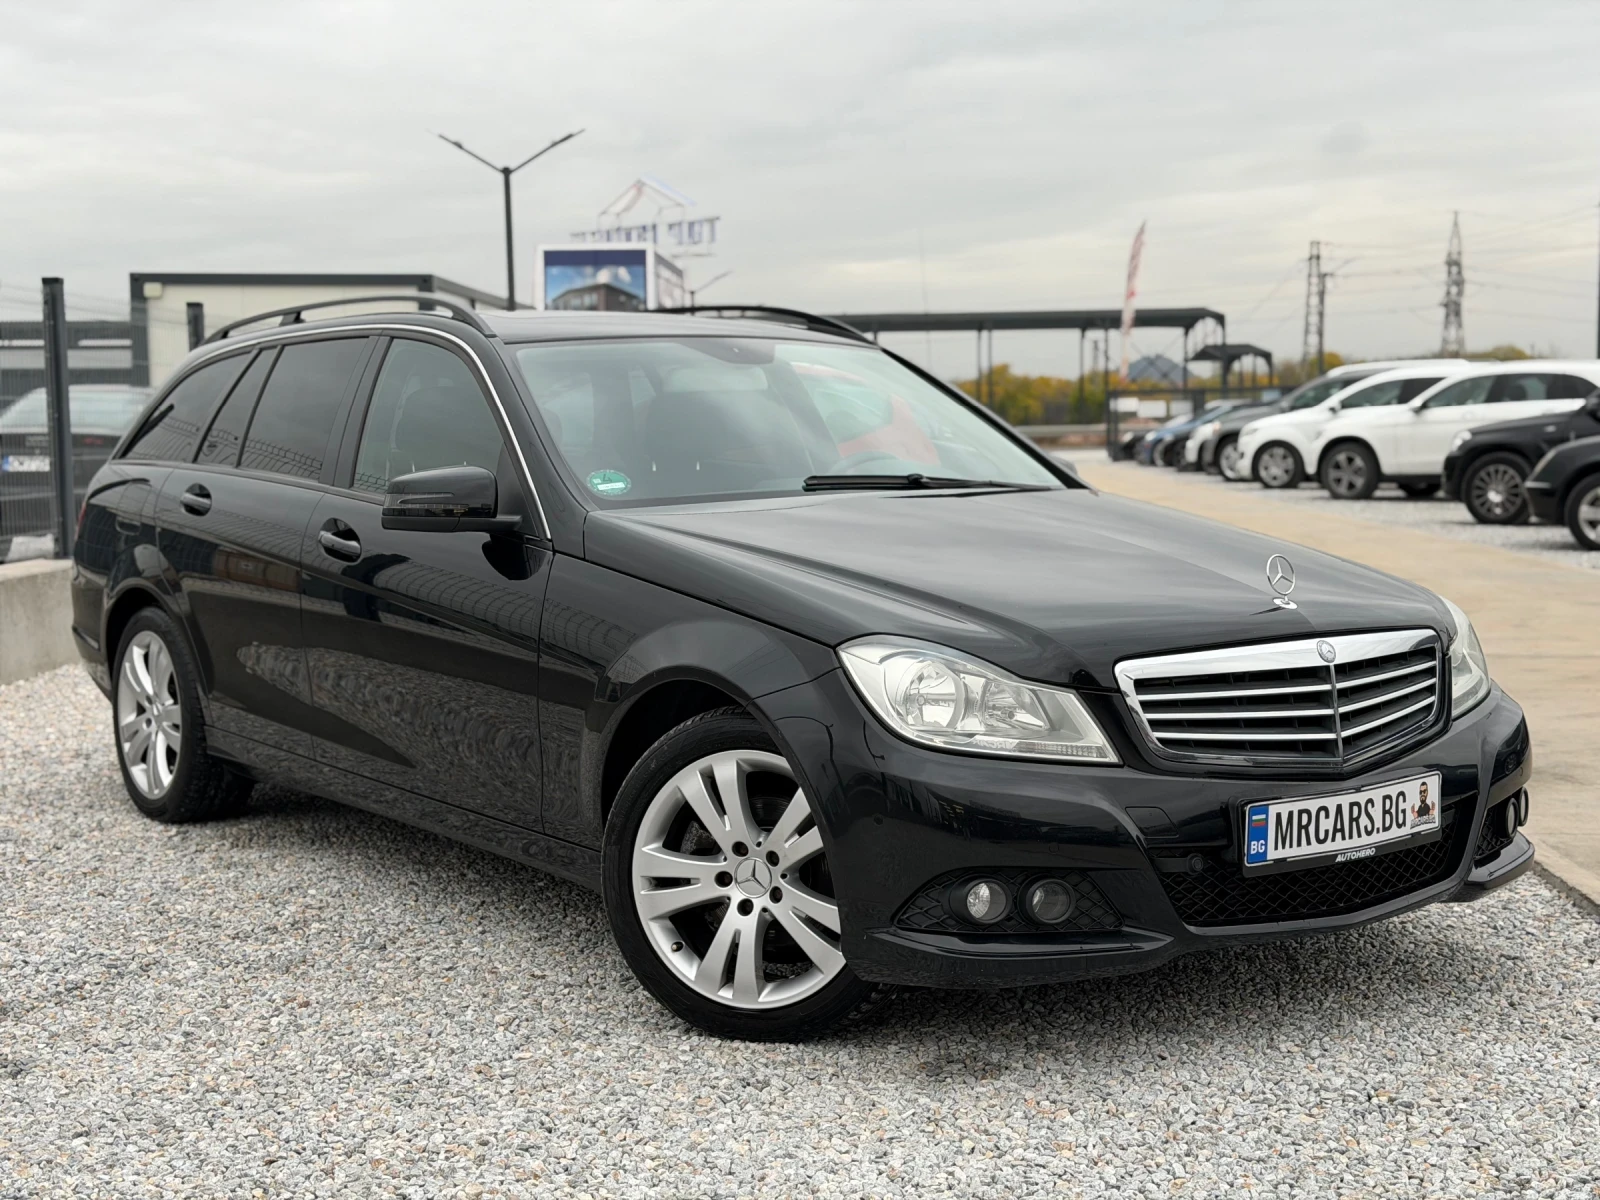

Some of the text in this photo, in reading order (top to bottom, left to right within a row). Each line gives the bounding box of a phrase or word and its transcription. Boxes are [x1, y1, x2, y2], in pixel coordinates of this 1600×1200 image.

[1274, 790, 1407, 851] MRCARS.BG
[1250, 840, 1266, 855] BG
[1335, 847, 1376, 863] AUTOHERO
